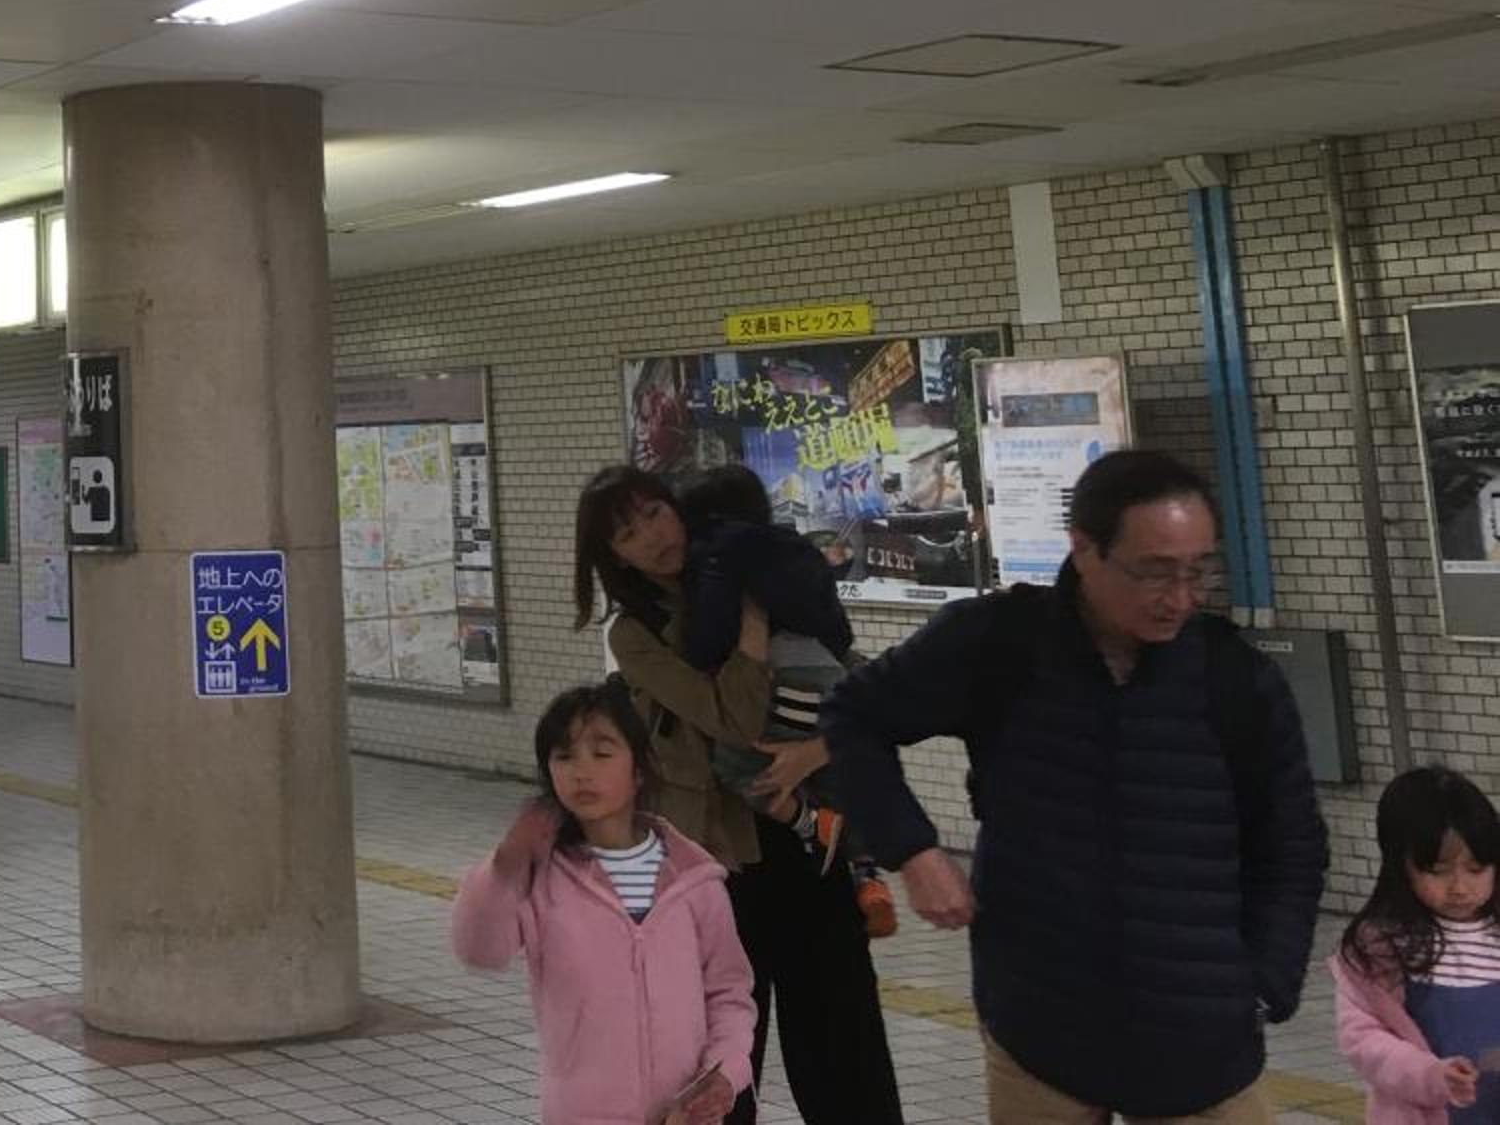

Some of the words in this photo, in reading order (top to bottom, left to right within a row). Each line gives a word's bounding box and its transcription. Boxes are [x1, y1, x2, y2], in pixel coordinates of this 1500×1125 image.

[739, 311, 856, 337] 交通局トピックス
[198, 564, 283, 590] 地上への
[197, 594, 282, 615] エレベータ
[211, 620, 225, 637] 5
